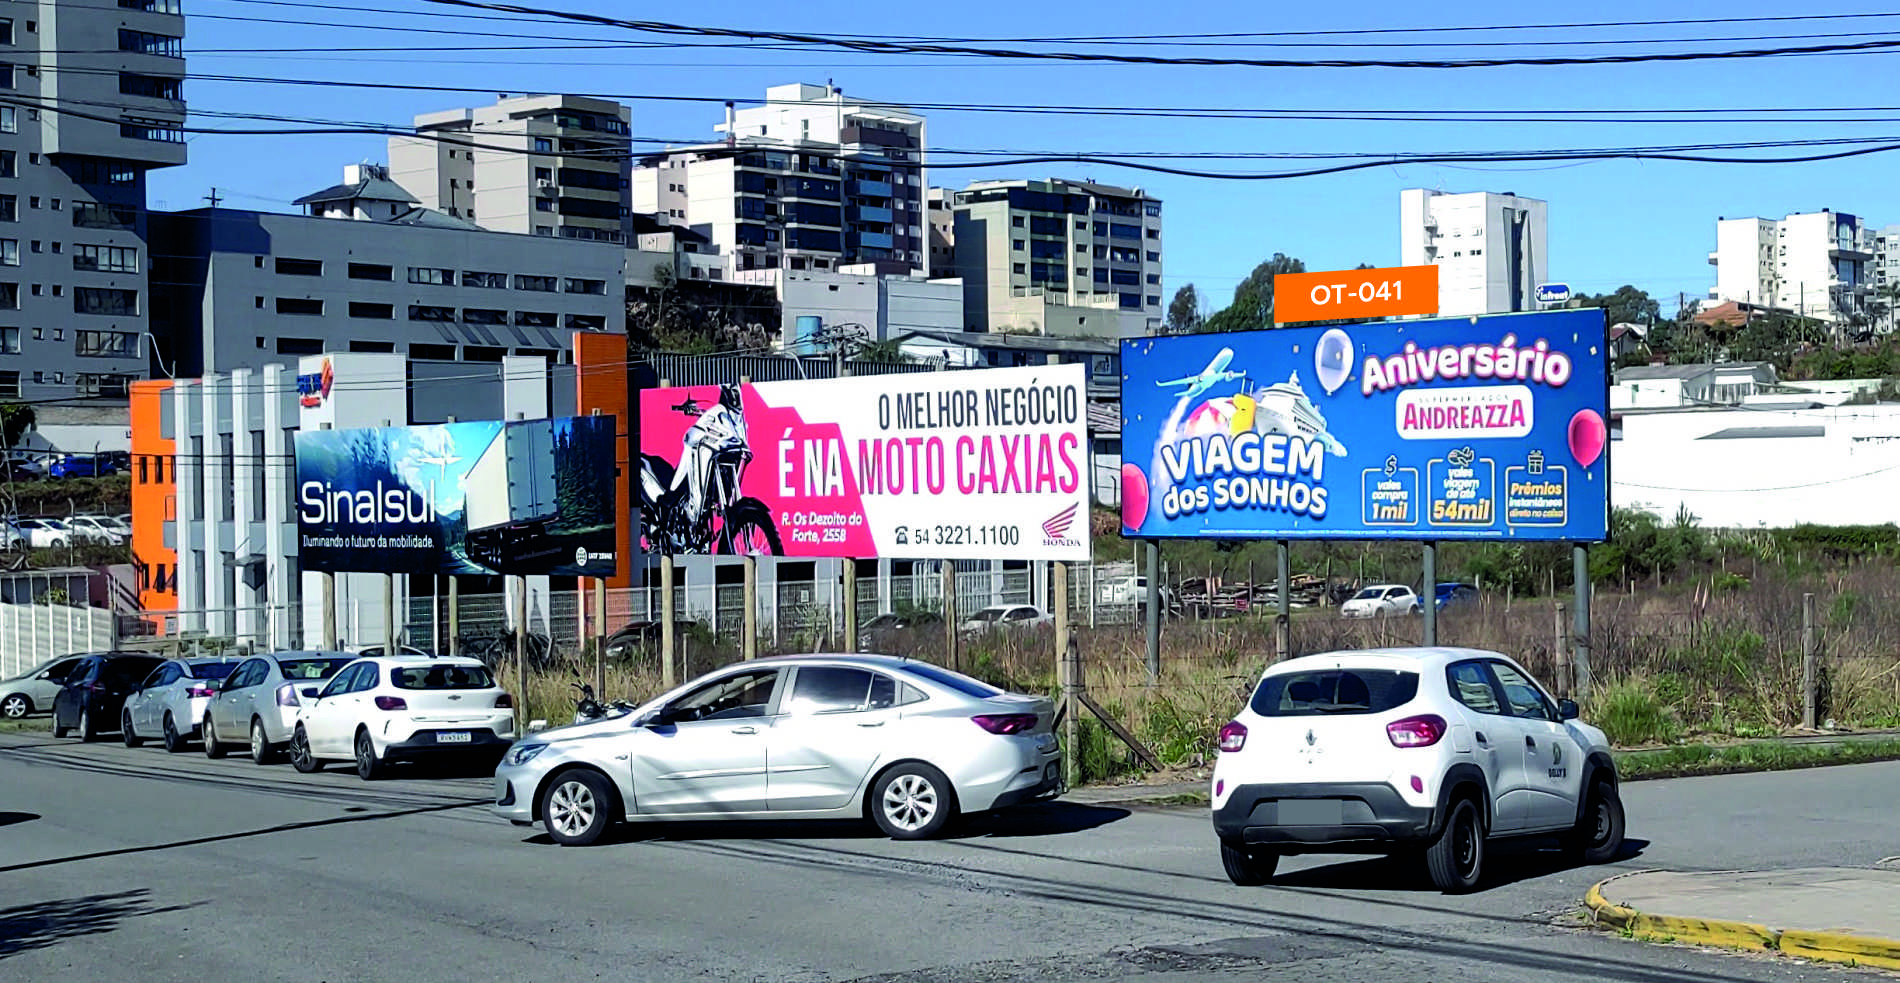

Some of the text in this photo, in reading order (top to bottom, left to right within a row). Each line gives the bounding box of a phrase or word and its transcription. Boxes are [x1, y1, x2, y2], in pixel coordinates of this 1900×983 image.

[1363, 334, 1571, 394] Aniversário
[879, 377, 1078, 430] O MELHOR NEGÓCIO
[1403, 399, 1526, 430] ANDREAZZA
[778, 426, 1080, 497] É NA MOTO CAXIAS
[1161, 431, 1325, 482] VIAGEM
[1443, 478, 1480, 491] viagem
[1511, 481, 1562, 496] Prêmios
[301, 479, 436, 523] Sinalsul
[1163, 476, 1328, 517] dos SONHOS
[1372, 491, 1409, 503] compra
[782, 511, 863, 526] R. Os Dezoito do
[1433, 498, 1490, 520] 54mil
[344, 540, 350, 548] o
[351, 534, 376, 548] futuro
[377, 534, 388, 548] da
[792, 528, 847, 544] Forte, 2558
[915, 525, 1020, 546] 54 3221.1100
[1043, 538, 1081, 547] HONDA
